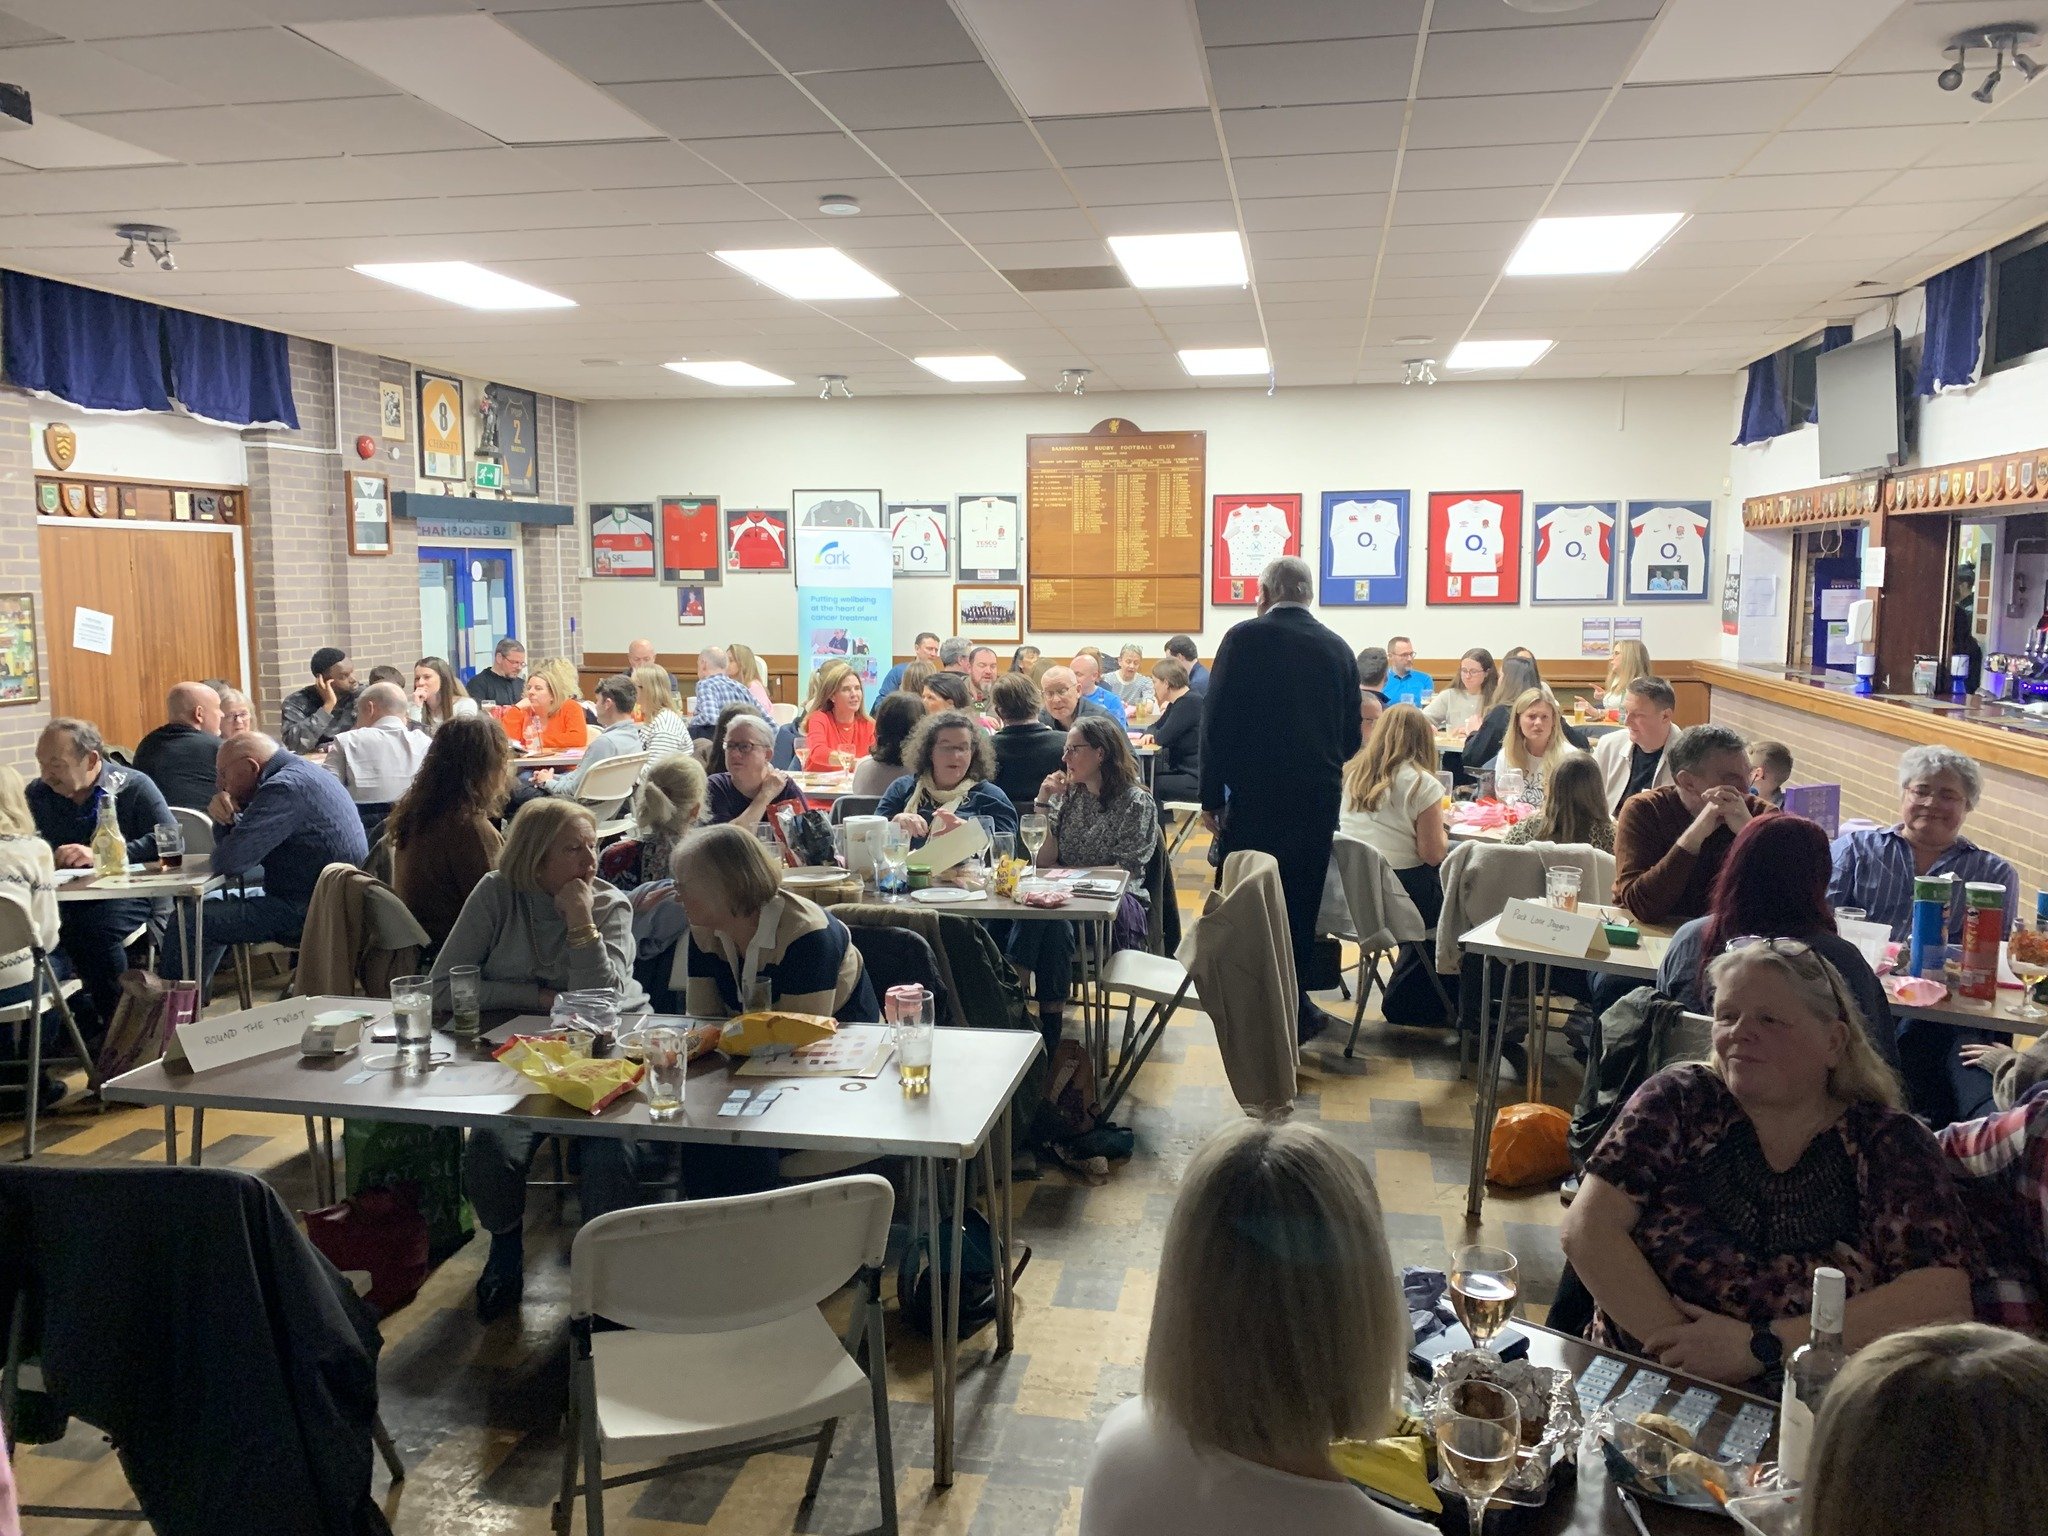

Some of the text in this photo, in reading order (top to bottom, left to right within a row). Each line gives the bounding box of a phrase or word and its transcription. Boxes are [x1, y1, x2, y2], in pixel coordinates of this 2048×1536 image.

[439, 402, 448, 431] 8
[513, 419, 521, 444] 2
[417, 525, 489, 537] HAMPIONS
[825, 550, 850, 565] ark
[810, 596, 877, 605] Putting wellbeing
[204, 1010, 305, 1045] ROUND THE TWIST
